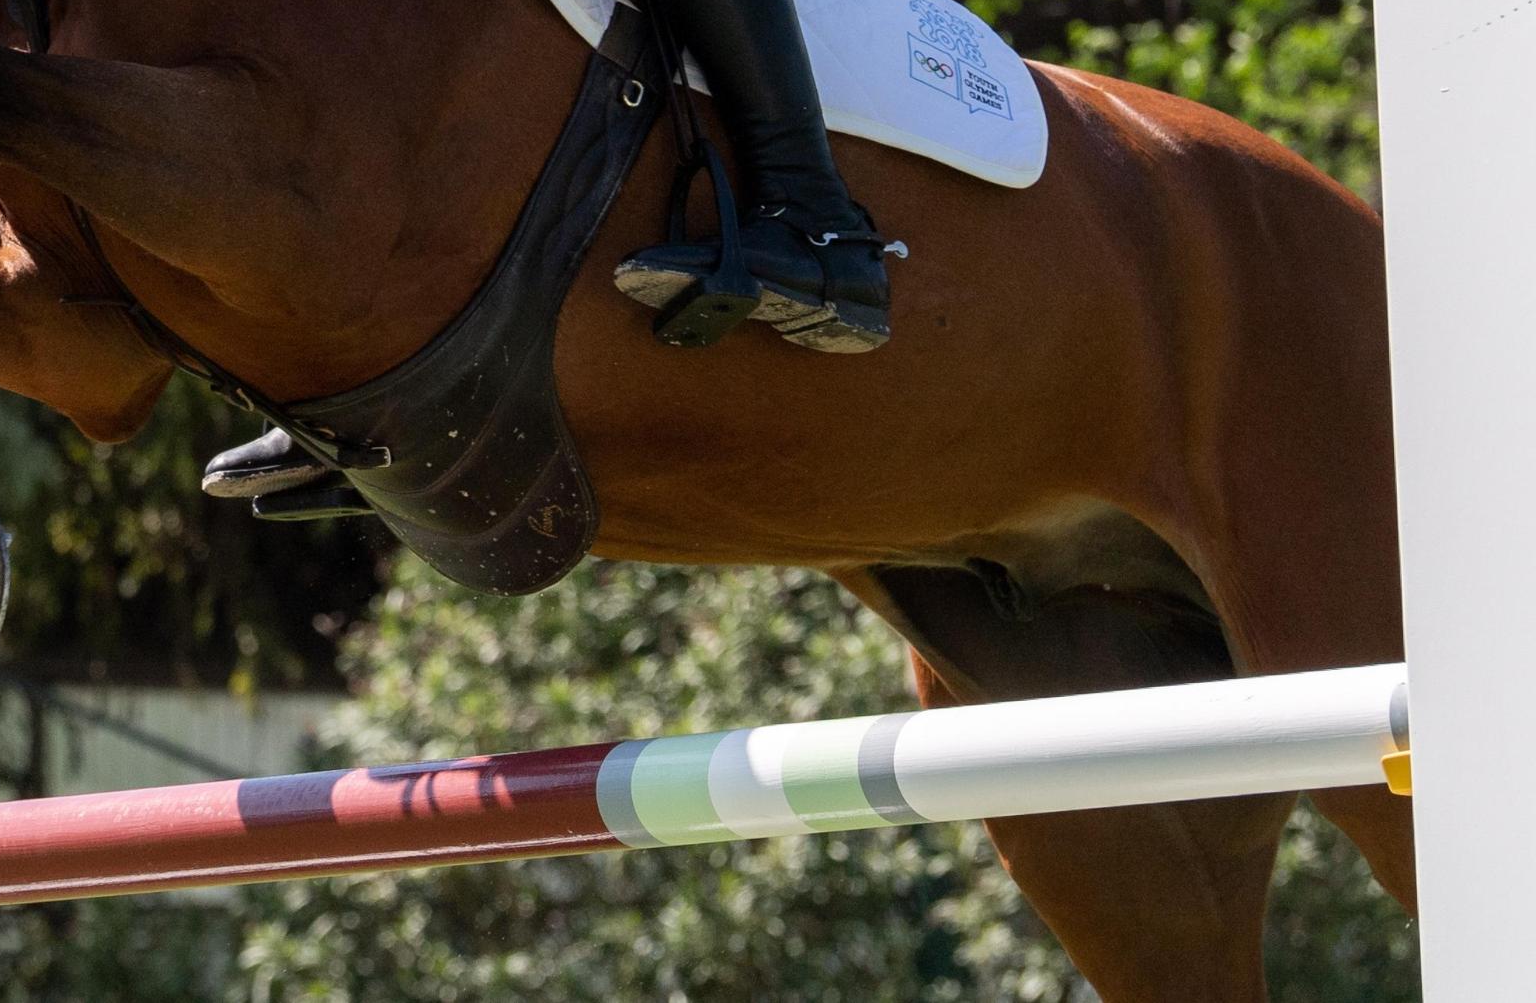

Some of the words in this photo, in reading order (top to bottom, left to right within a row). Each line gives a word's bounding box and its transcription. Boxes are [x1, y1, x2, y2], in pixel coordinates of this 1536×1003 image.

[964, 78, 1005, 103] OLYMPIC
[966, 68, 998, 92] YOUTH
[969, 91, 1002, 110] GAMES
